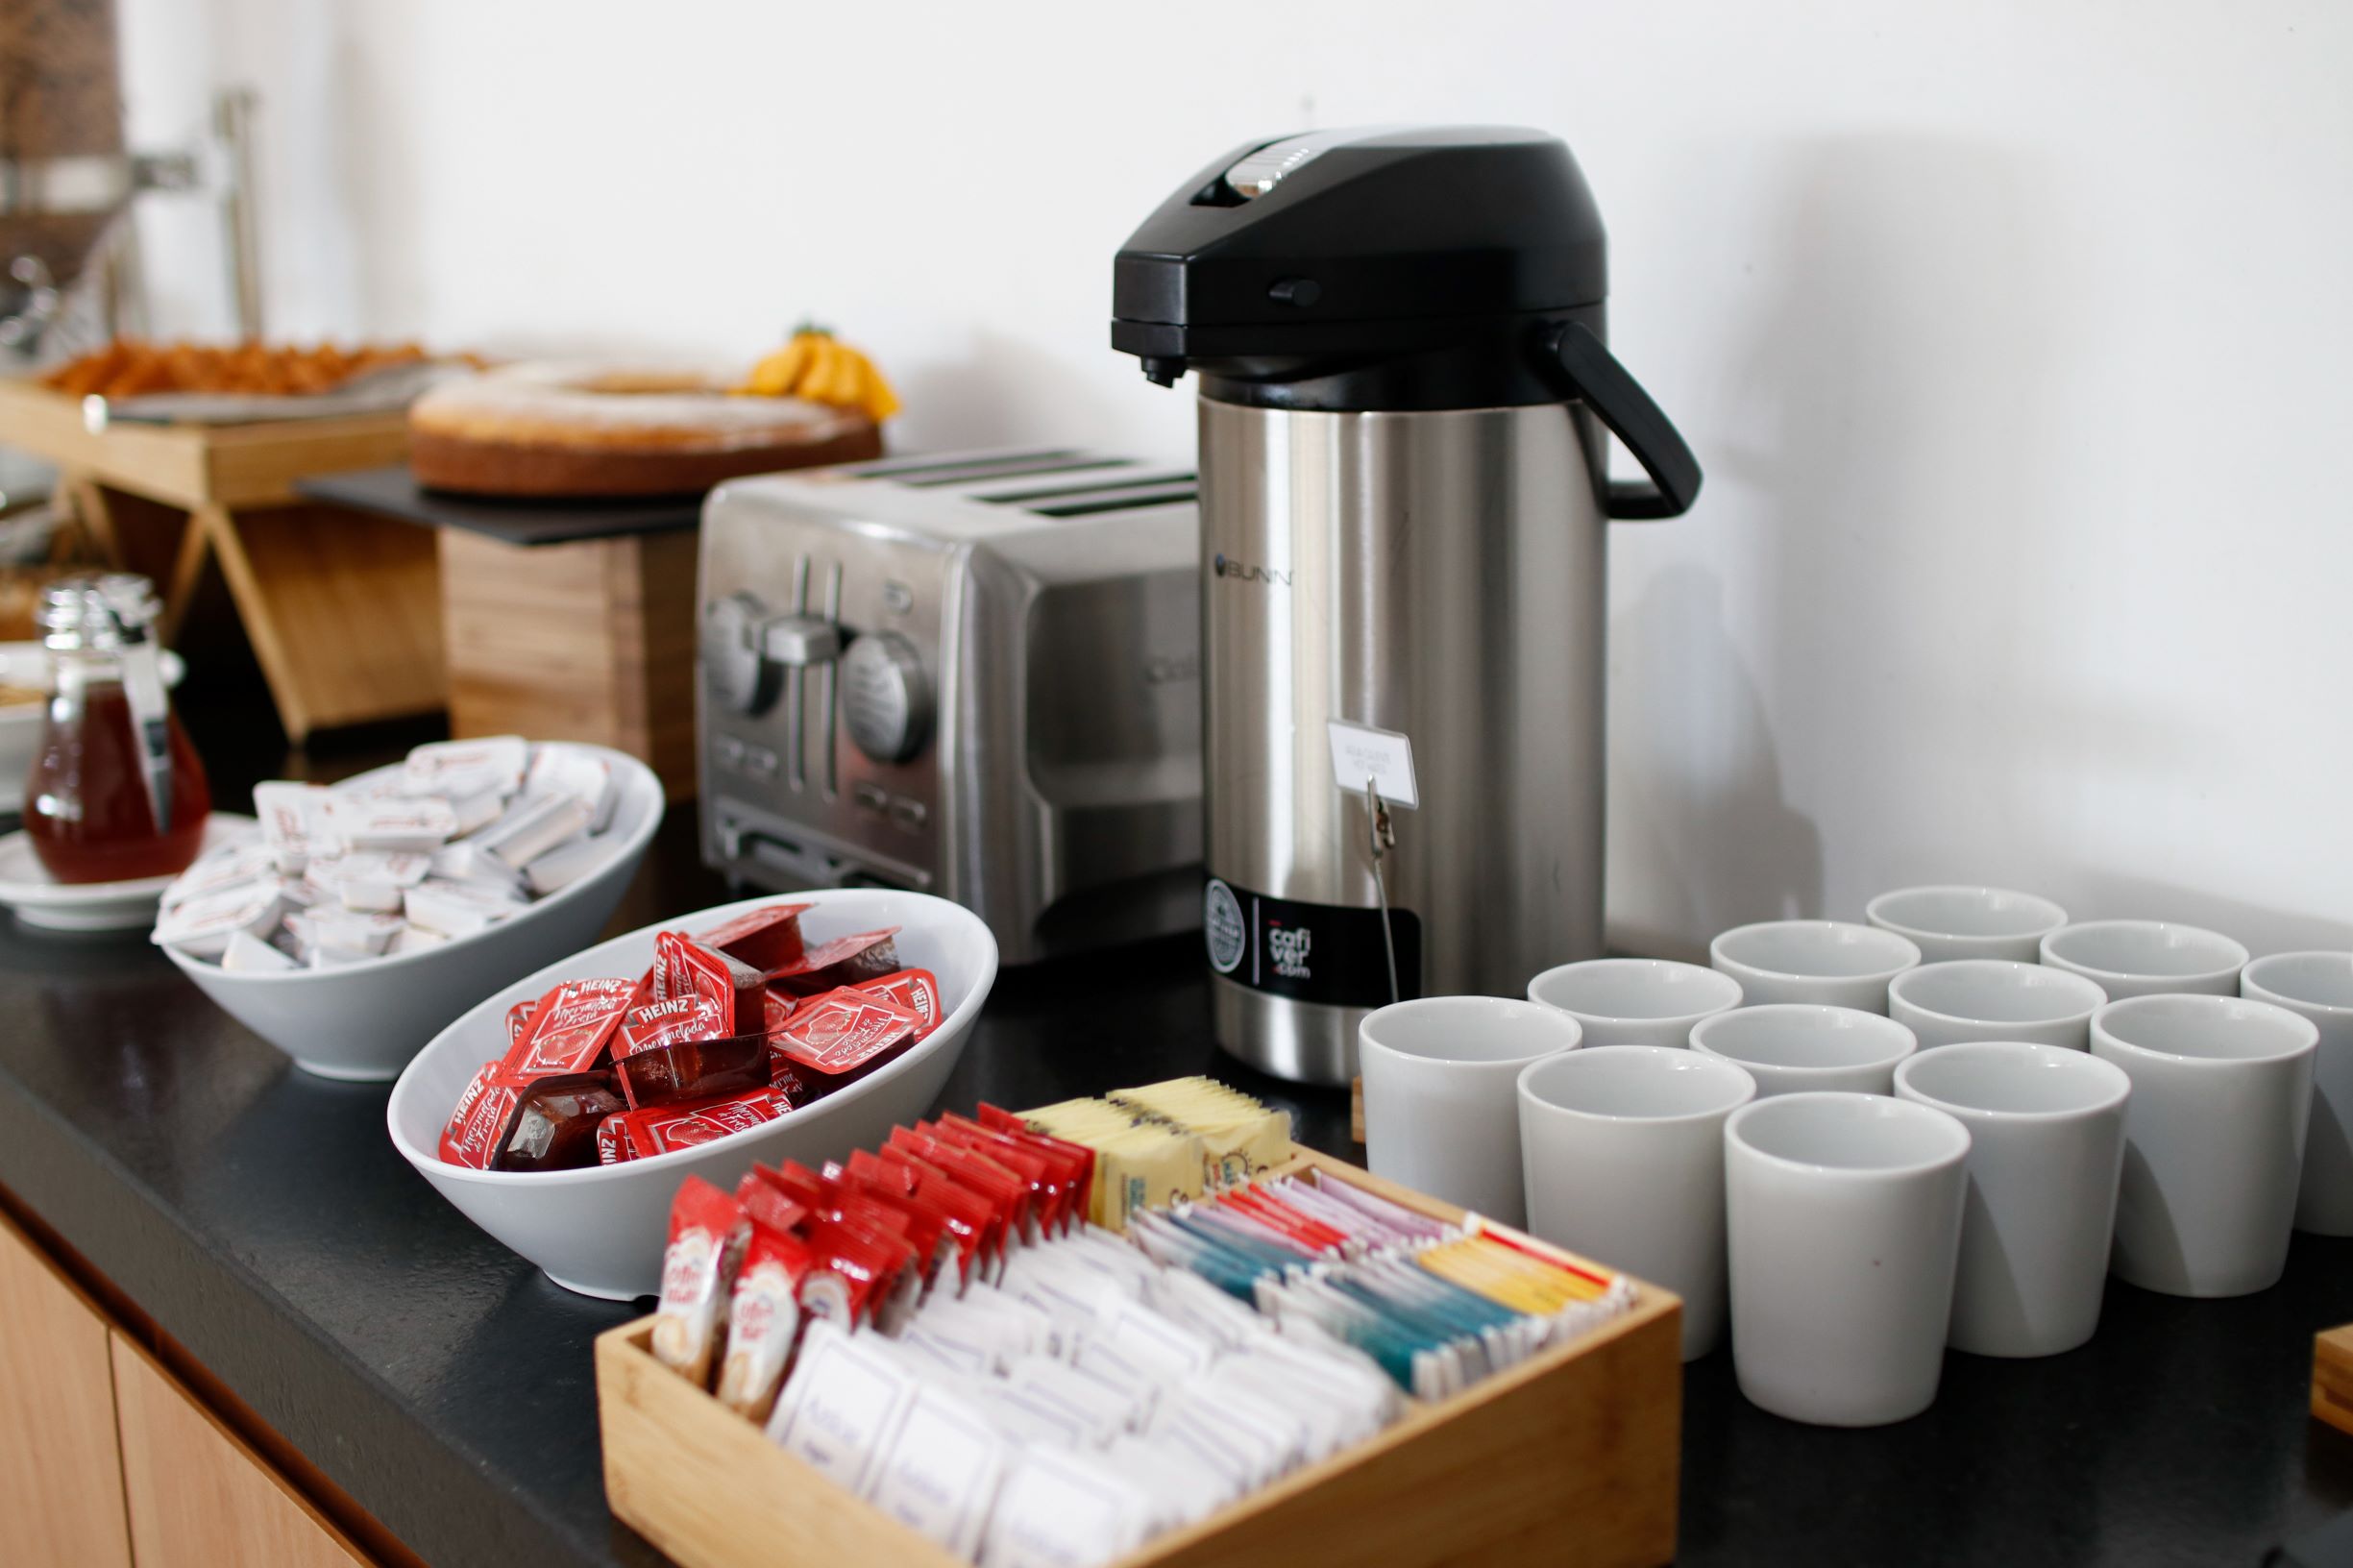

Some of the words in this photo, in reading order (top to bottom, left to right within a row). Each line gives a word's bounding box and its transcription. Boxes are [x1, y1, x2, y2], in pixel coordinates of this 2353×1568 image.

[1227, 560, 1293, 586] BUNN
[1269, 928, 1311, 953] cafi
[1270, 944, 1310, 966] ver
[580, 979, 623, 994] HEINZ
[657, 954, 668, 1001] HEINZ
[639, 999, 689, 1023] HEINZ
[911, 987, 929, 1020] HEIN
[857, 1032, 901, 1058] HEINZ
[453, 1080, 484, 1124] HEINZ
[601, 1138, 616, 1165] INZ
